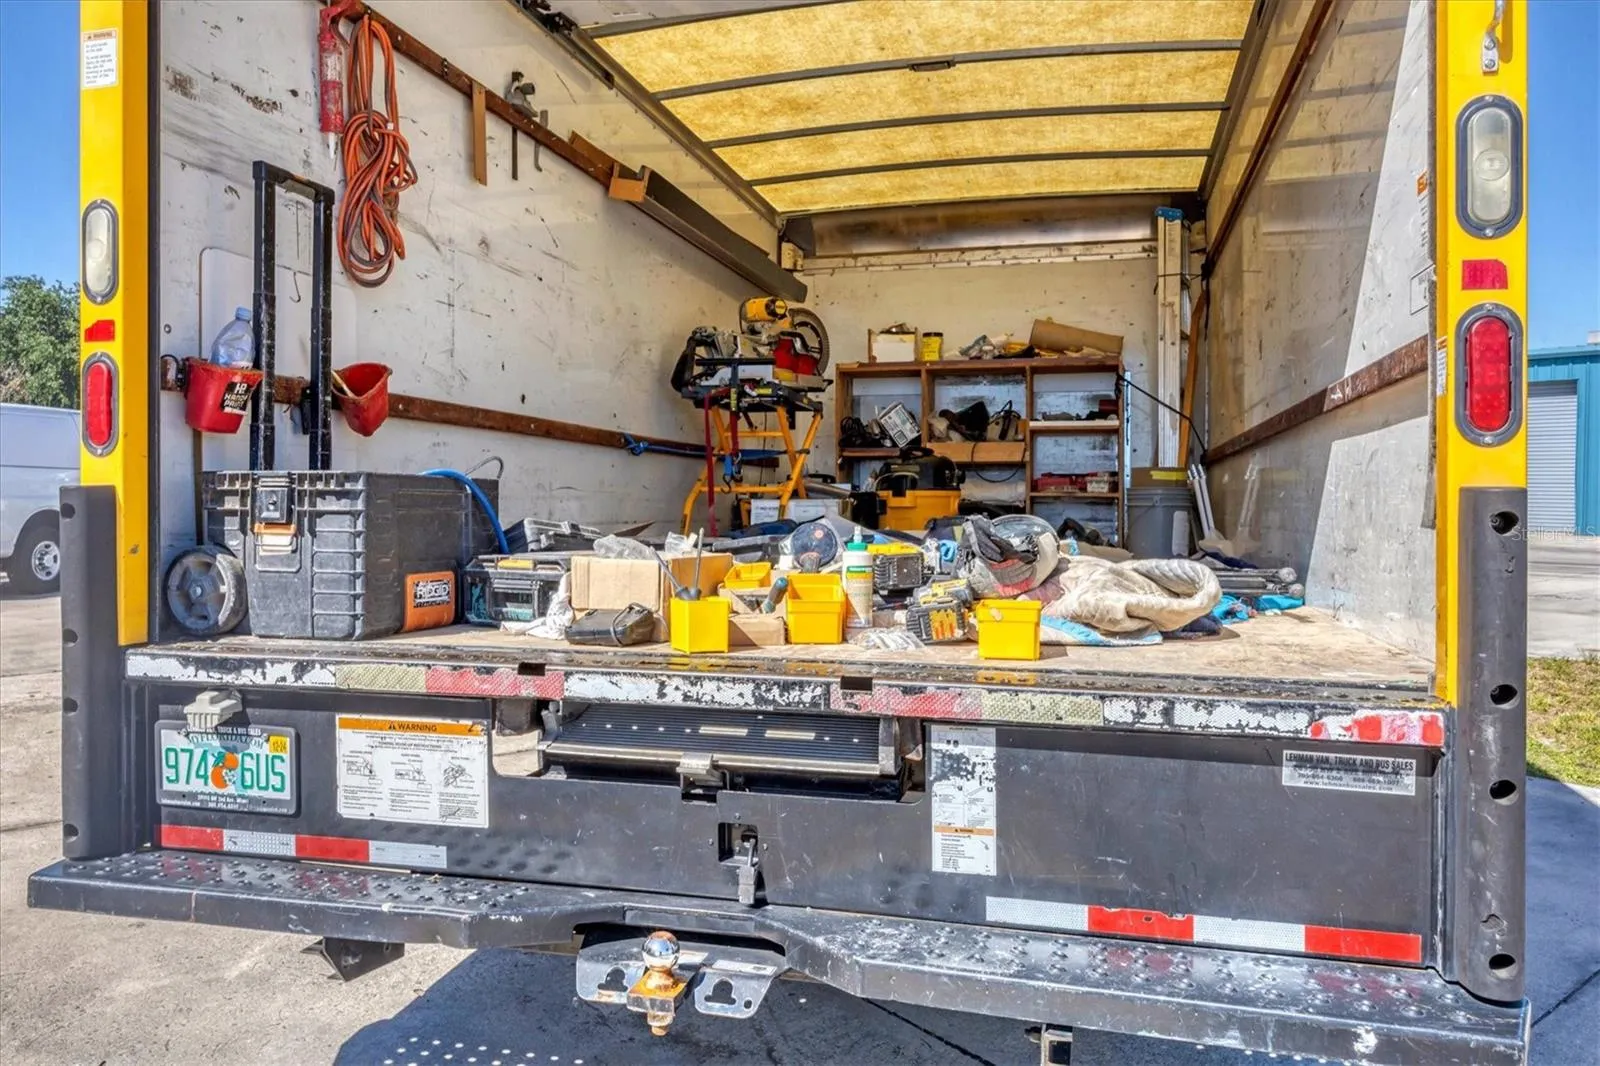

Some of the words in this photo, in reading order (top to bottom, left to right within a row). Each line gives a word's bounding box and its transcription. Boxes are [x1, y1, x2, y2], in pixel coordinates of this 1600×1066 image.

[397, 722, 438, 733] WARNING
[165, 747, 209, 786] 974
[241, 752, 286, 793] 6US
[1285, 752, 1315, 763] LEHMAN
[1334, 756, 1358, 767] TRUCK
[1359, 758, 1374, 768] AND
[1376, 759, 1390, 770] BUS
[1391, 760, 1414, 771] SALES
